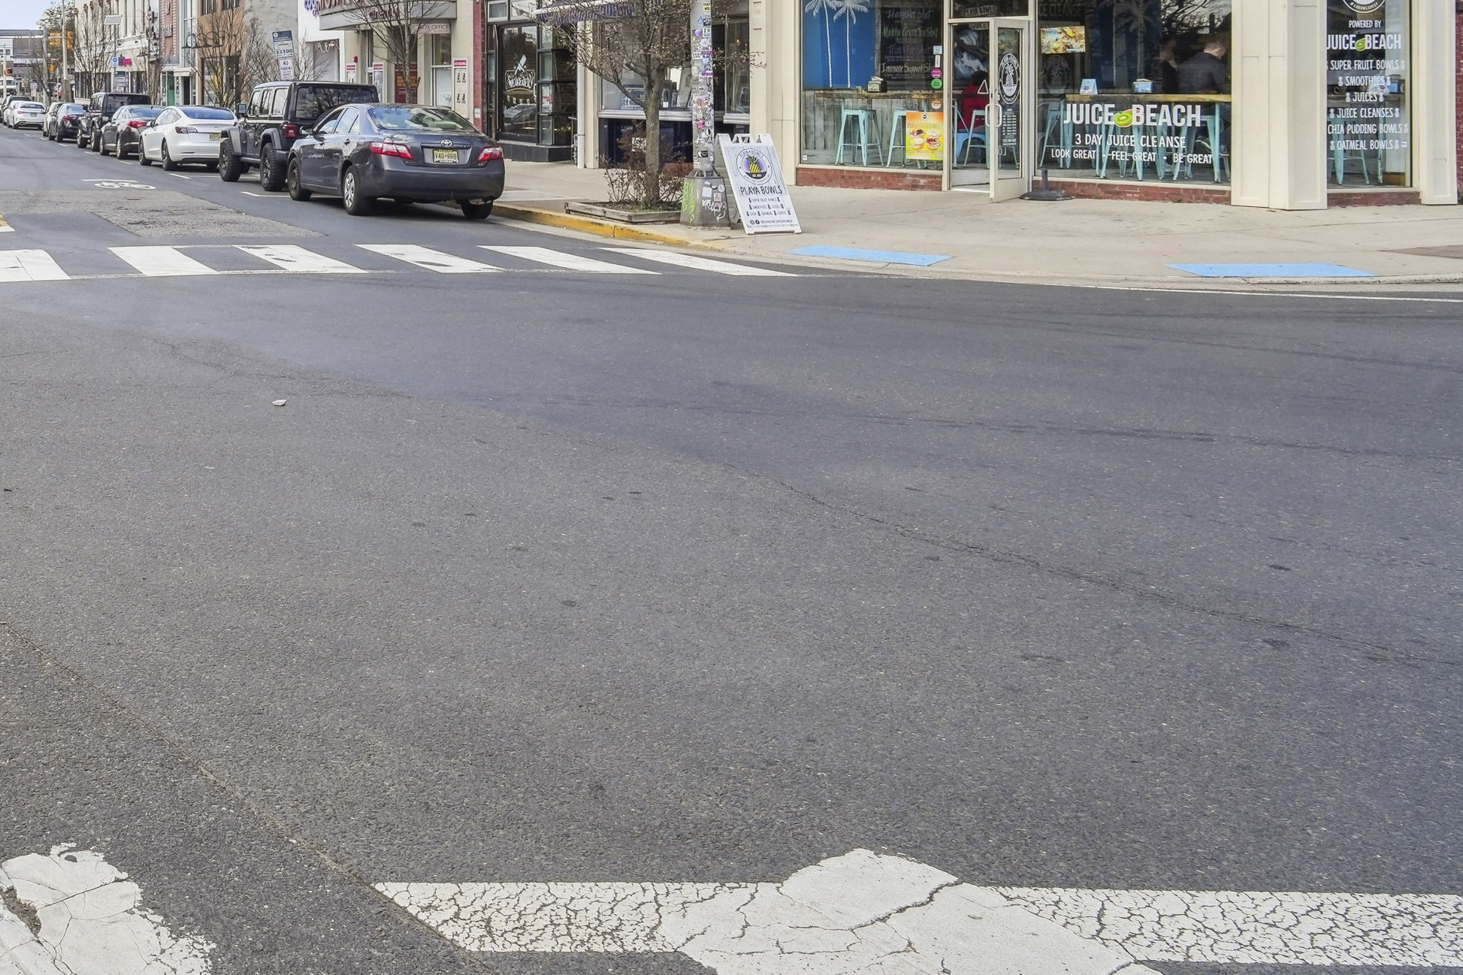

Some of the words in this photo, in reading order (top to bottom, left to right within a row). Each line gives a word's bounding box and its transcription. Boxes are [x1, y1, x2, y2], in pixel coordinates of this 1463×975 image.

[1348, 19, 1373, 29] POWERED
[1374, 19, 1382, 28] BY
[1326, 34, 1356, 50] JUICE
[1364, 34, 1402, 50] BEACH
[1330, 60, 1352, 71] SUPER
[1354, 59, 1374, 70] FRUIT
[1376, 59, 1400, 70] BOWLS
[1345, 76, 1386, 86] SMOOTHIES
[1353, 92, 1378, 102] JUICES
[1063, 103, 1116, 125] JUICE
[1132, 104, 1201, 127] BEACH
[1337, 107, 1358, 118] JUICE
[1360, 107, 1394, 118] CLEANSES
[1328, 124, 1345, 134] CHIA
[1347, 124, 1377, 134] PUDDING
[1380, 124, 1403, 134] BOWLS
[1075, 133, 1081, 145] 3
[1085, 134, 1103, 146] DAY
[1107, 134, 1135, 146] JUICE
[1140, 135, 1186, 148] CLEANSE
[1337, 140, 1368, 150] OATMEAL
[1370, 139, 1393, 150] BOWLS
[1051, 148, 1070, 159] LOOK
[1073, 149, 1097, 160] GREAT
[1111, 151, 1129, 161] FEEL
[1132, 151, 1156, 162] GREAT
[1173, 153, 1183, 163] BE
[1187, 153, 1212, 164] GREAT
[740, 186, 760, 195] PLAYA
[760, 185, 783, 195] BOWLS
